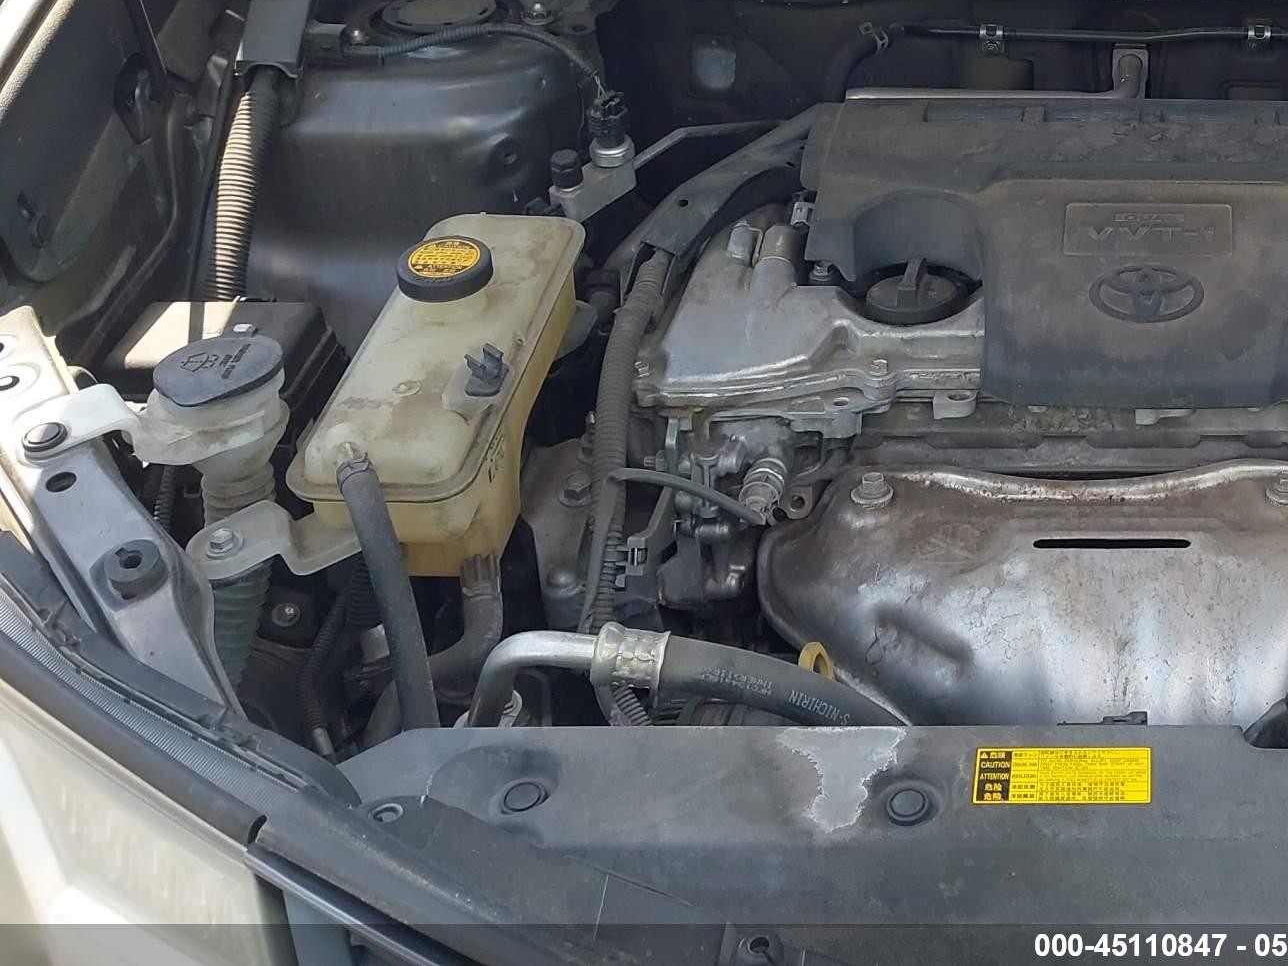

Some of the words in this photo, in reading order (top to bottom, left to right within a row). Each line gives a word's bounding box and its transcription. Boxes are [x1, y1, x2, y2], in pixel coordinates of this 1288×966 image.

[788, 689, 850, 726] S-NICHIRIN
[980, 760, 1011, 769] CAUTION
[979, 772, 1010, 781] ATTENTION
